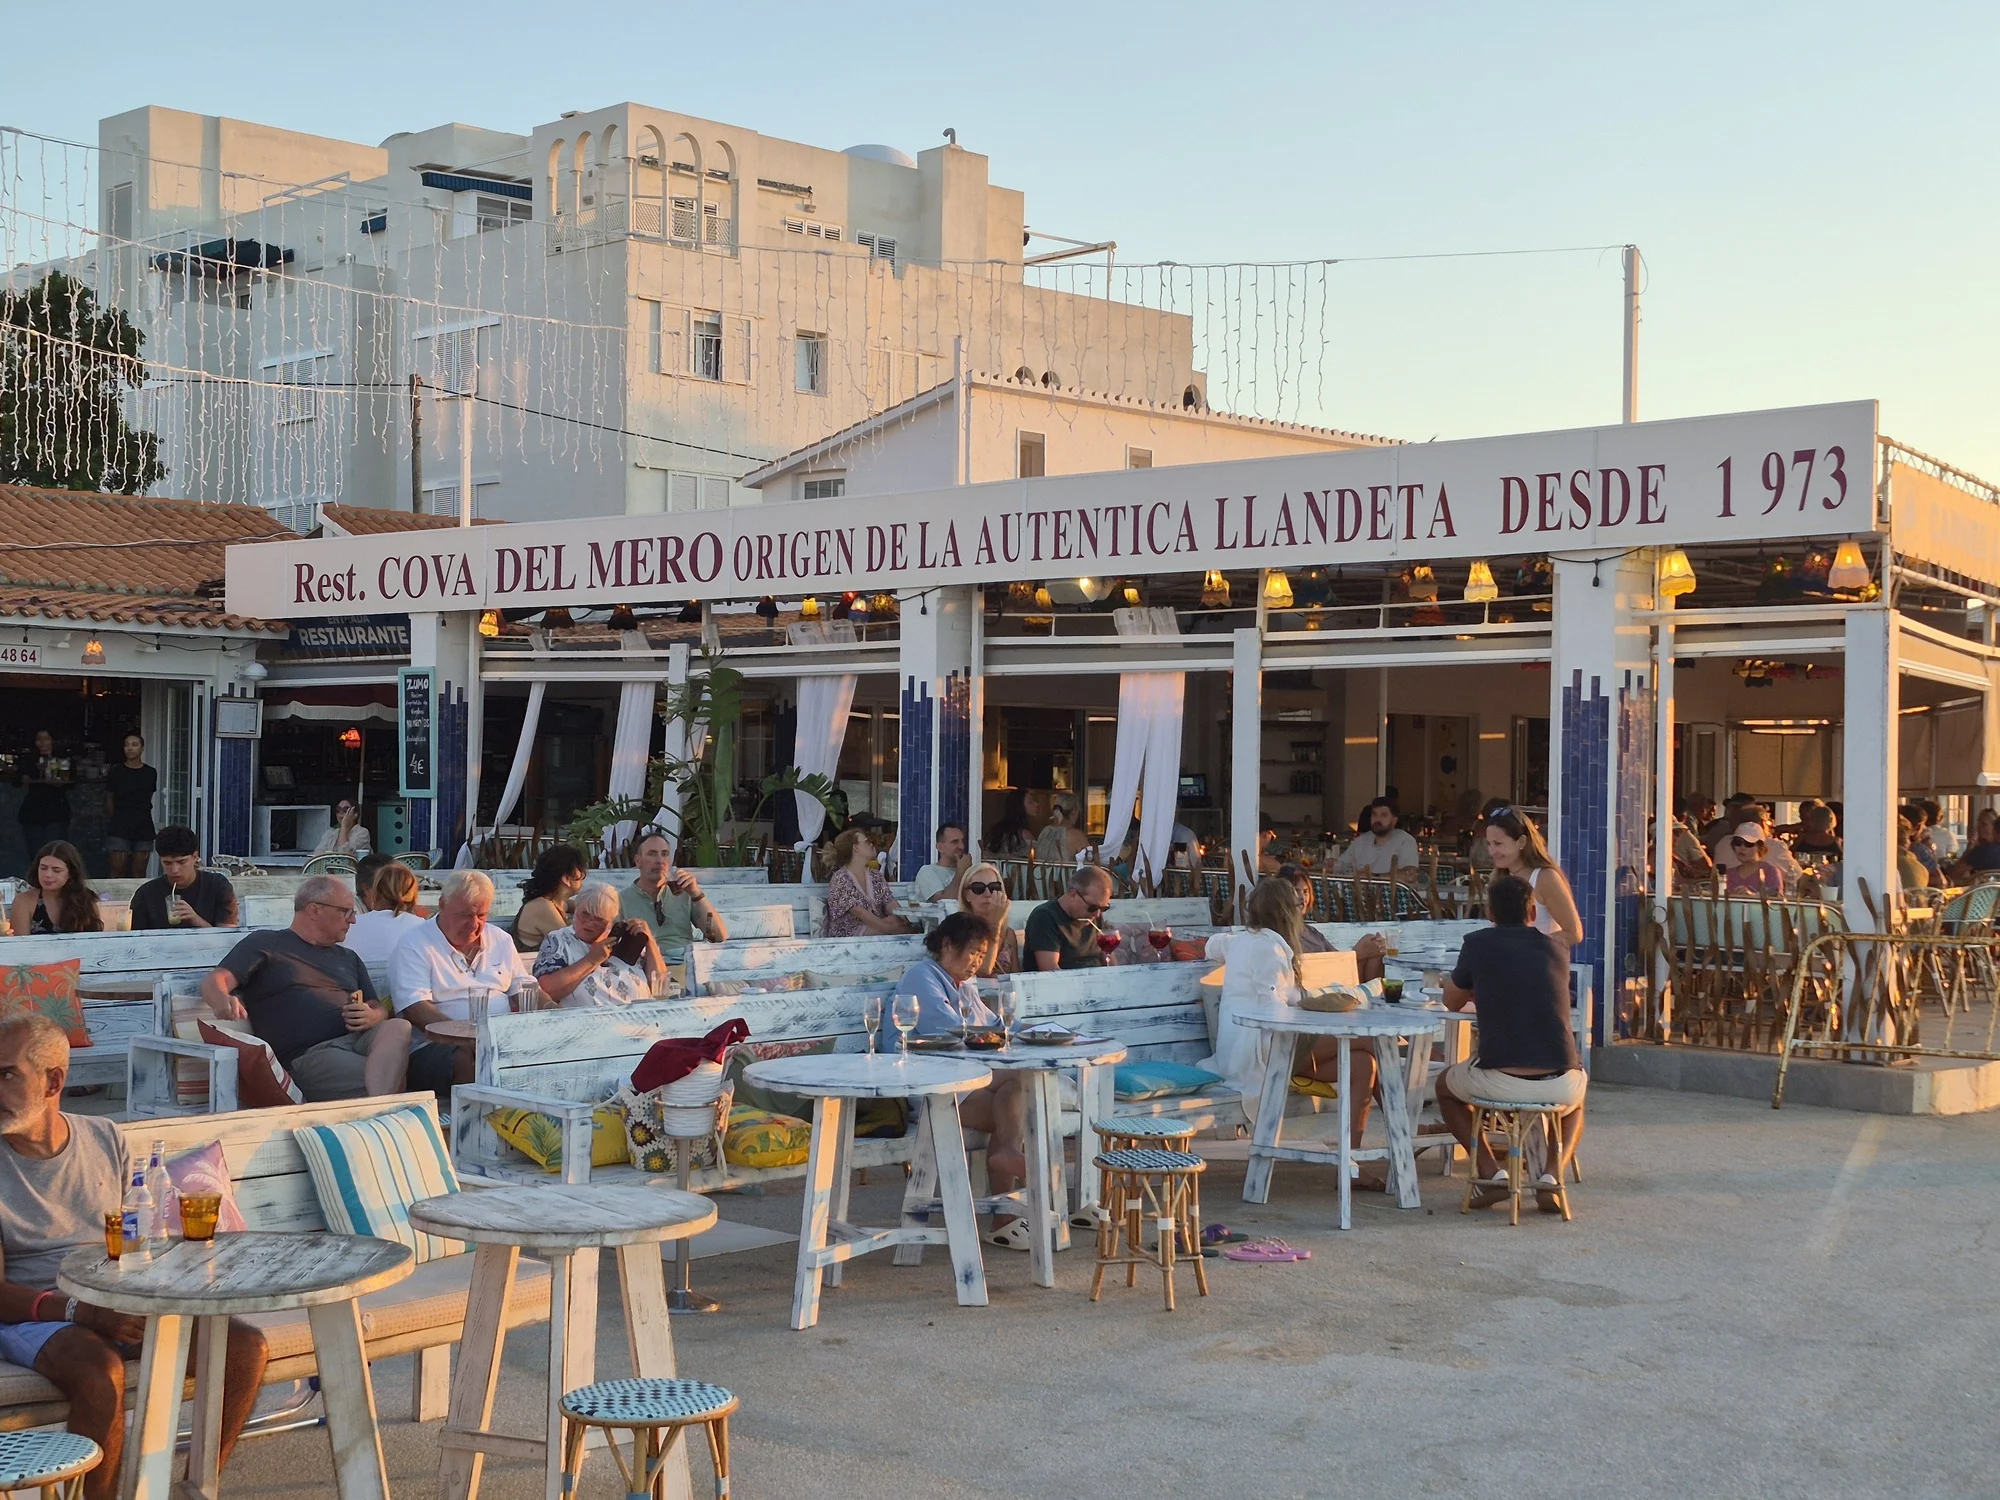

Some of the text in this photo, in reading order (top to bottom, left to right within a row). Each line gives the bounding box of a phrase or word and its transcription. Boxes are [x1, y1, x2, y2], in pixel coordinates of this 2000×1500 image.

[293, 563, 366, 603] Rest.
[378, 552, 477, 600] COVA
[494, 544, 577, 594] DEL
[586, 531, 723, 589] MERO
[733, 528, 855, 582] ORIGEN
[865, 523, 908, 573] DE
[917, 519, 962, 569] LA
[974, 500, 1199, 565] AUTENTICA
[1214, 481, 1457, 550] LLANDETA
[1499, 464, 1667, 534] DESDE
[299, 625, 409, 646] RESTAURANTE
